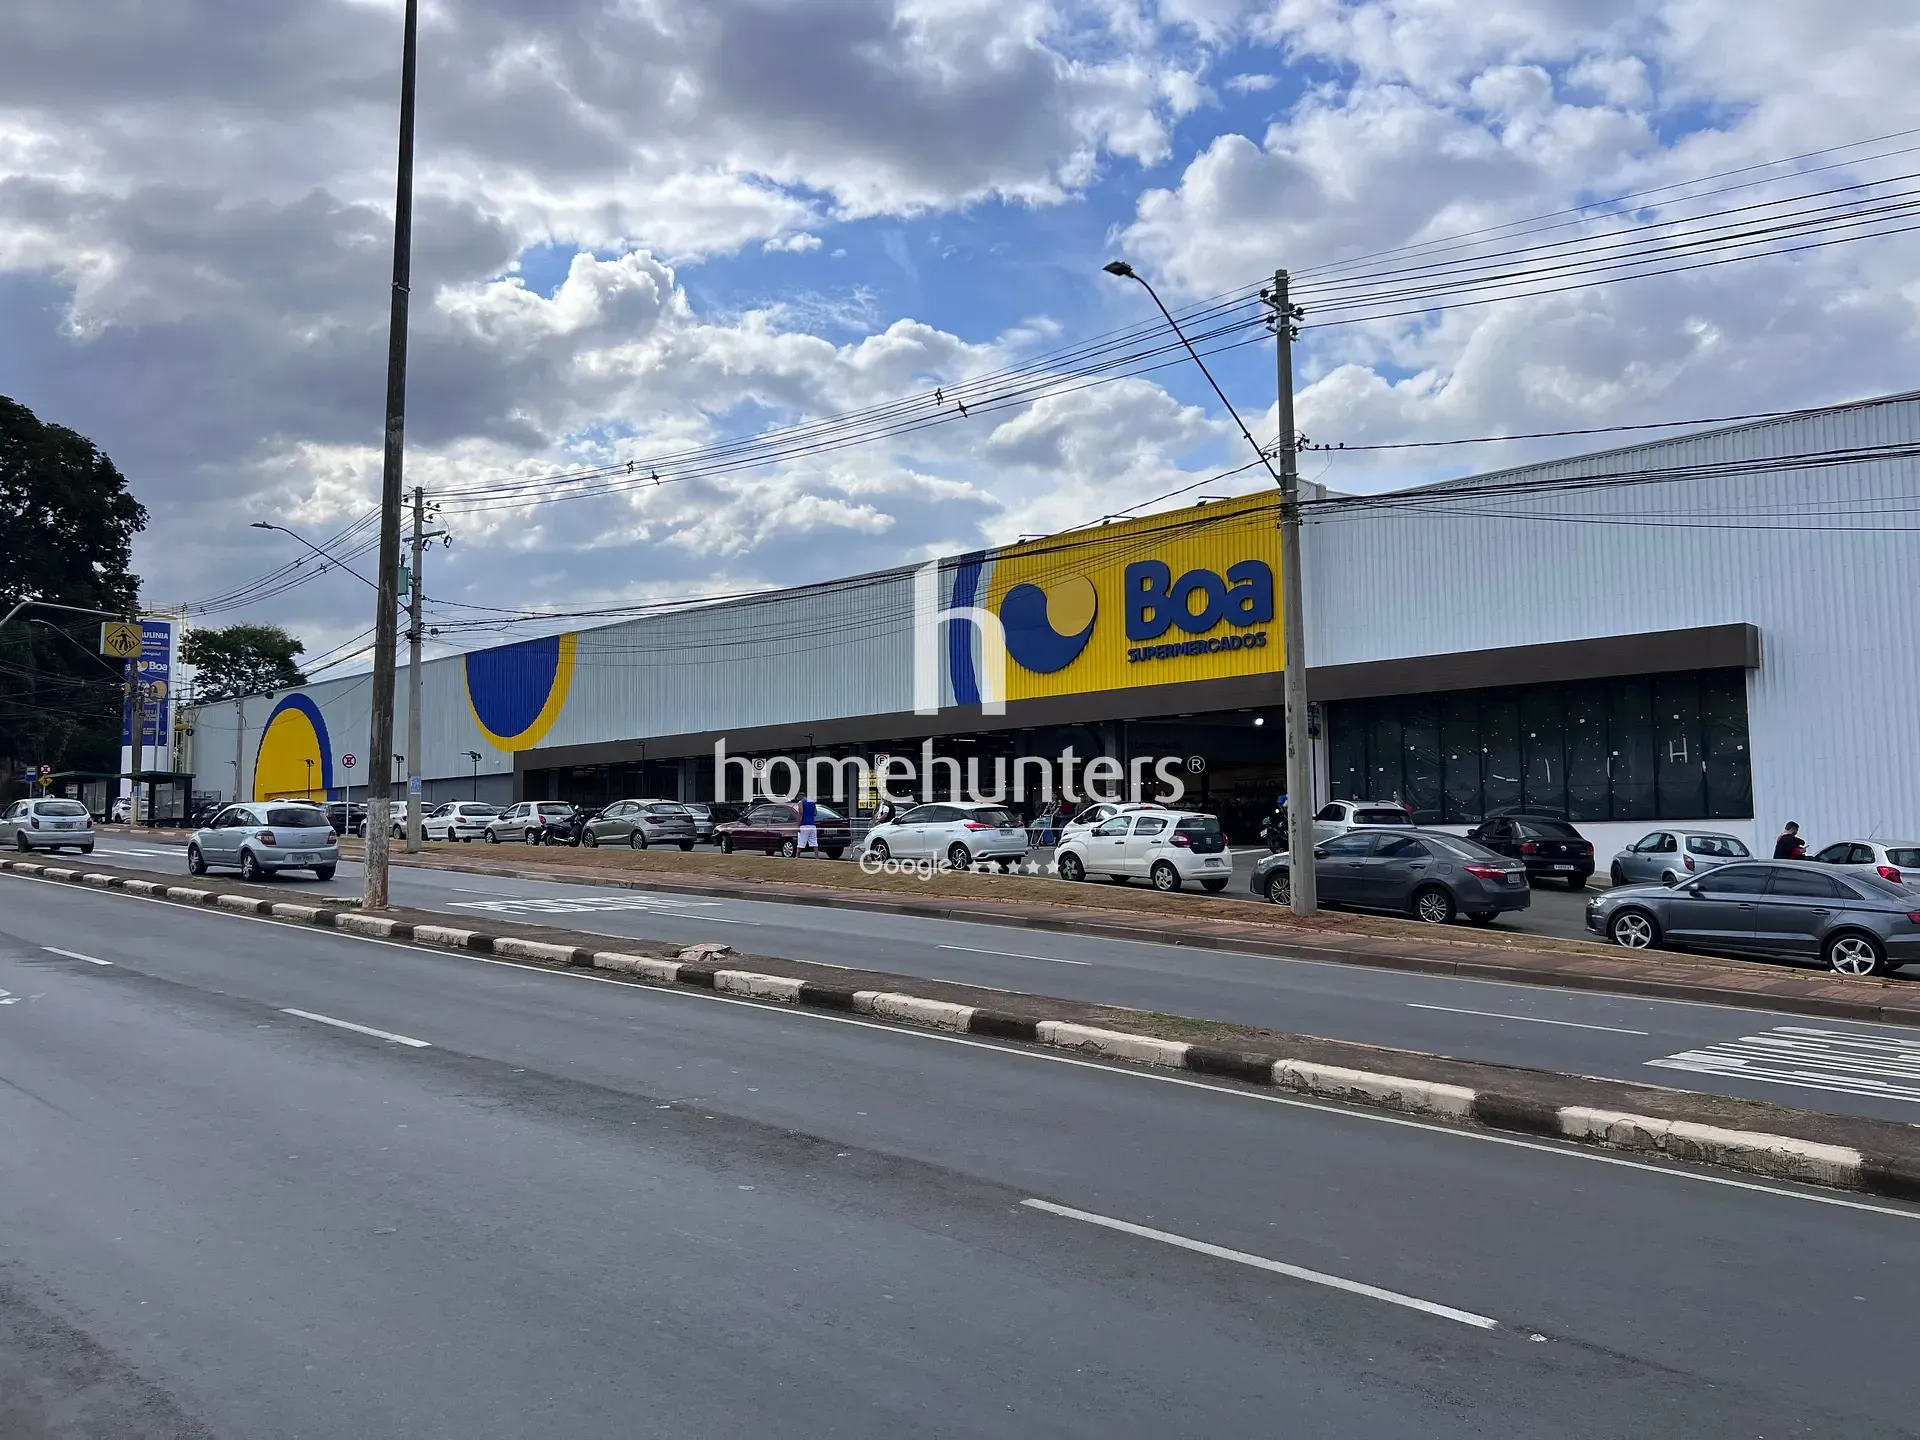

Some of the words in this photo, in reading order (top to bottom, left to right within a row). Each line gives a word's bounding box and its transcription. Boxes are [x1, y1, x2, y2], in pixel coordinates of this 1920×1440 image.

[1125, 559, 1274, 641] Boa
[1128, 631, 1267, 663] SUPERMERCADOS
[149, 661, 168, 671] Boa
